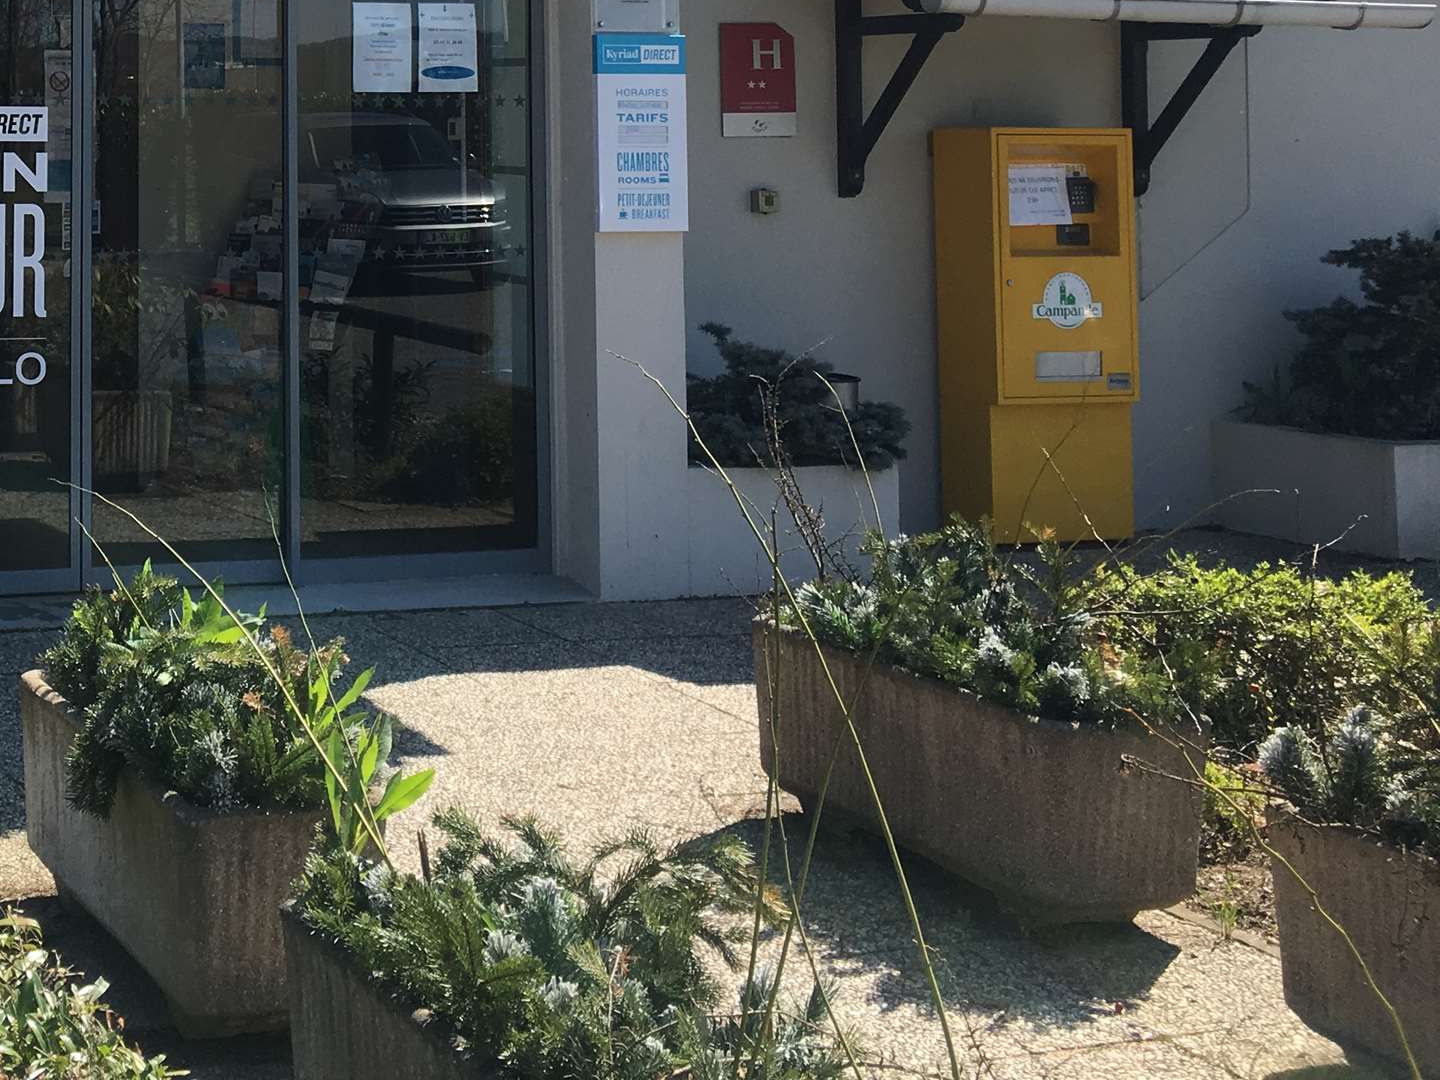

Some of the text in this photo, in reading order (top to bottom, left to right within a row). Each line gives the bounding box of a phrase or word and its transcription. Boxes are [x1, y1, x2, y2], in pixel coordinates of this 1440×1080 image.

[606, 48, 676, 61] Kyriad DIRECT
[752, 39, 781, 70] H
[615, 88, 669, 97] HORAIRES
[616, 113, 669, 123] TARIFS
[616, 152, 670, 172] CHAMBRES
[617, 176, 657, 184] ROOMS
[631, 208, 670, 220] BREAKFAST
[1037, 304, 1100, 320] Campane
